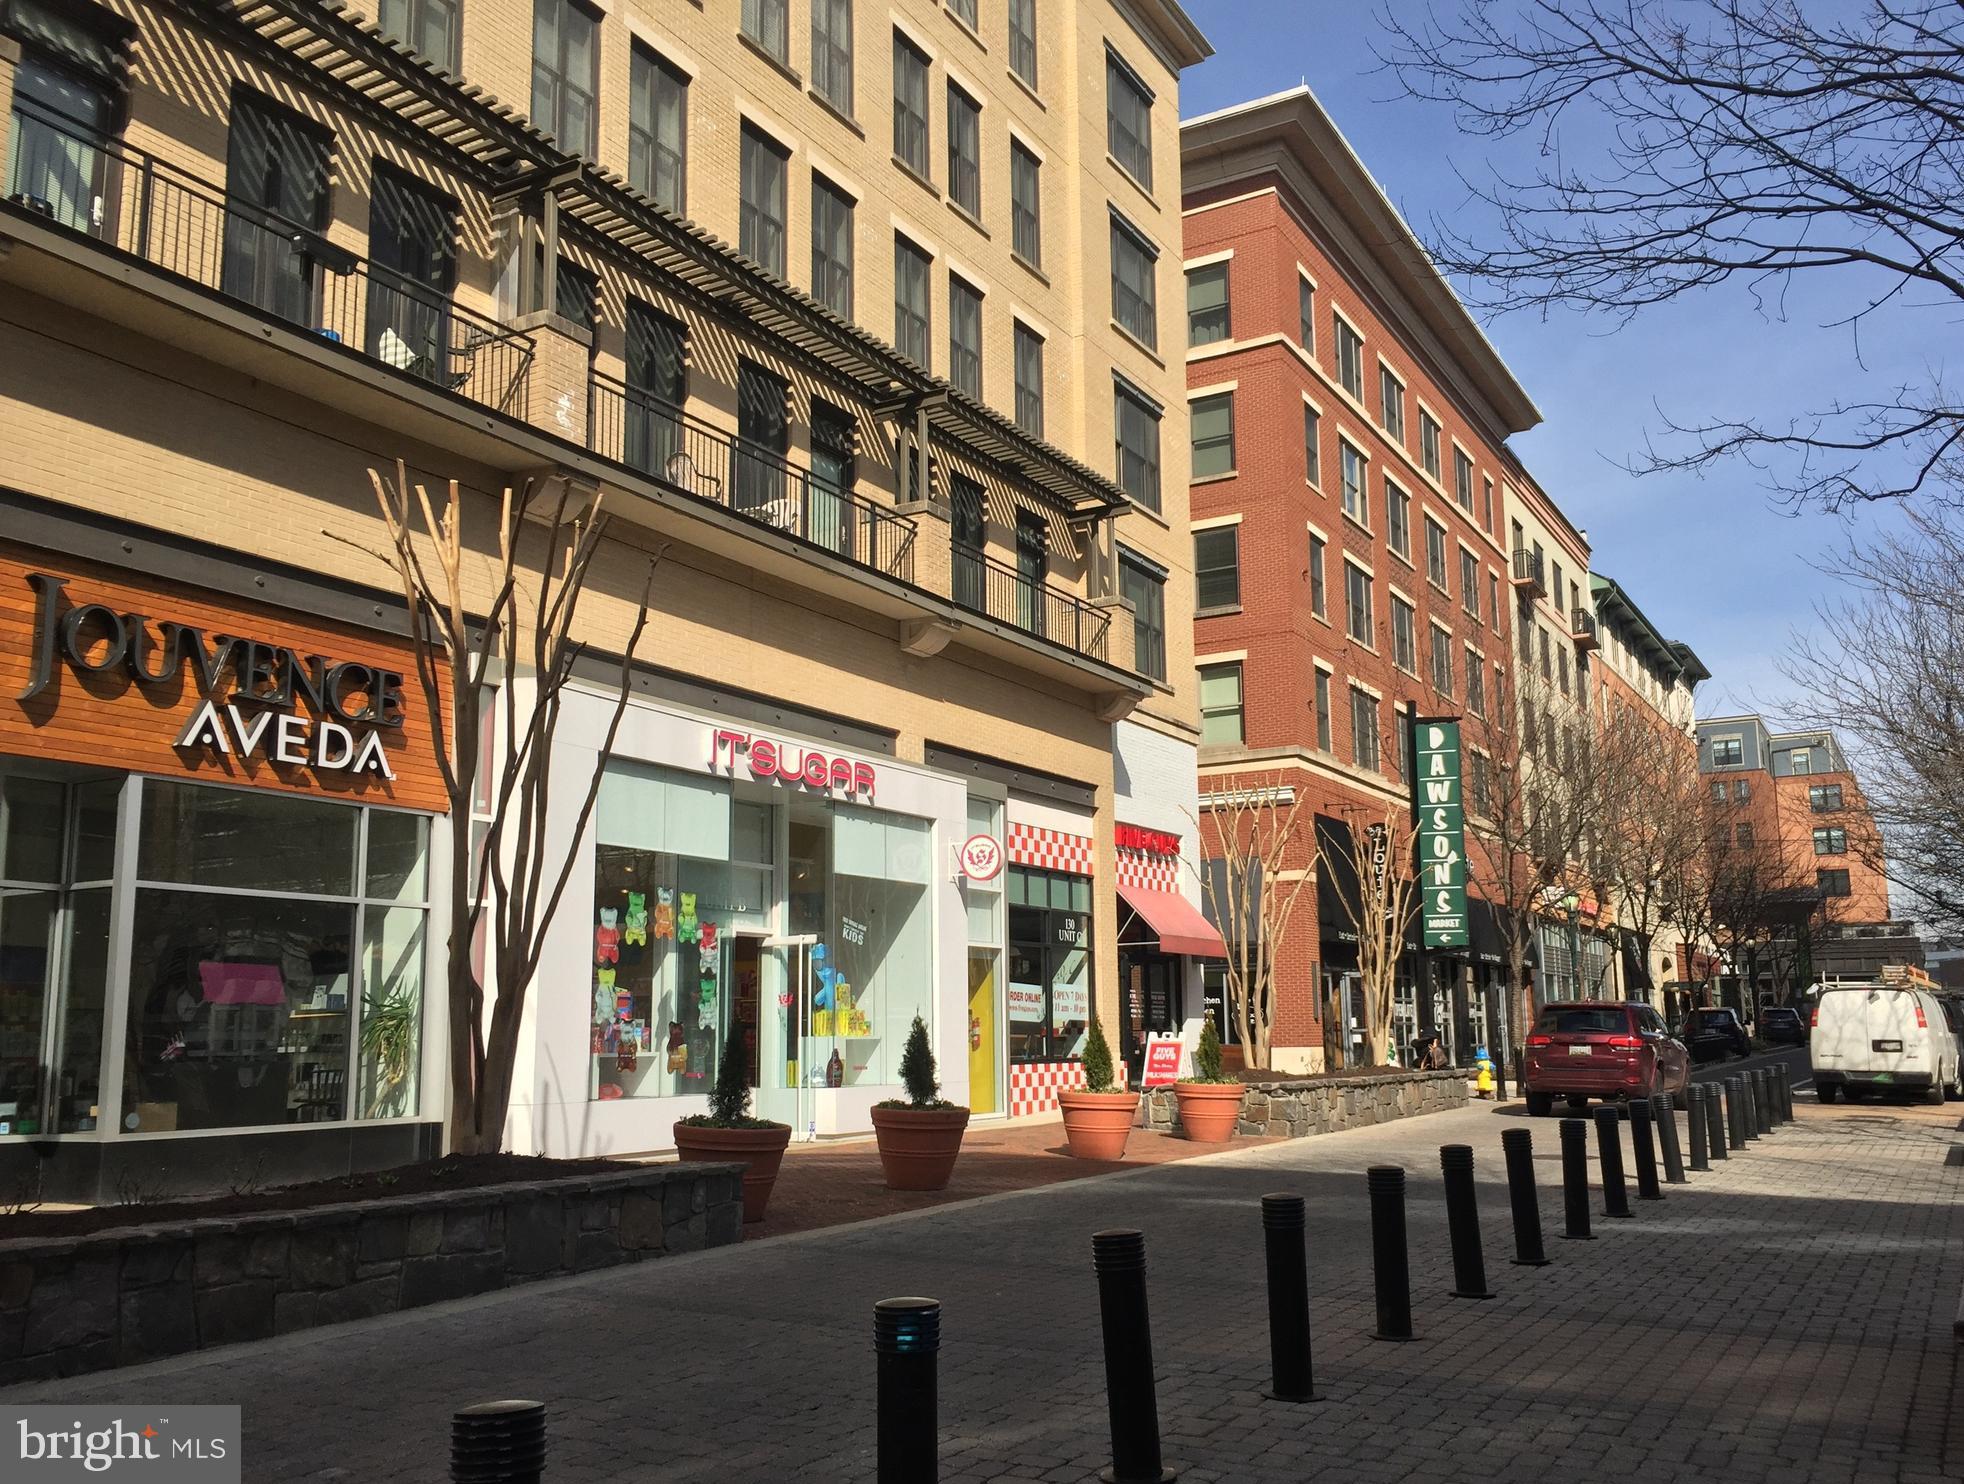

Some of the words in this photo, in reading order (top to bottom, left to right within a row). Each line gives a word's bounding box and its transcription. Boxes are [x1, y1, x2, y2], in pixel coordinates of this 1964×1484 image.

[17, 573, 404, 728] JOUVENCE
[181, 701, 392, 778] AVEDA
[713, 729, 875, 796] IT'SUGAR
[1065, 919, 1075, 930] 130
[1428, 918, 1460, 929] MARKET
[842, 927, 864, 945] KIDS
[1059, 929, 1075, 941] UNIT
[1009, 991, 1023, 1001] RDER
[1054, 990, 1069, 1000] OPEN
